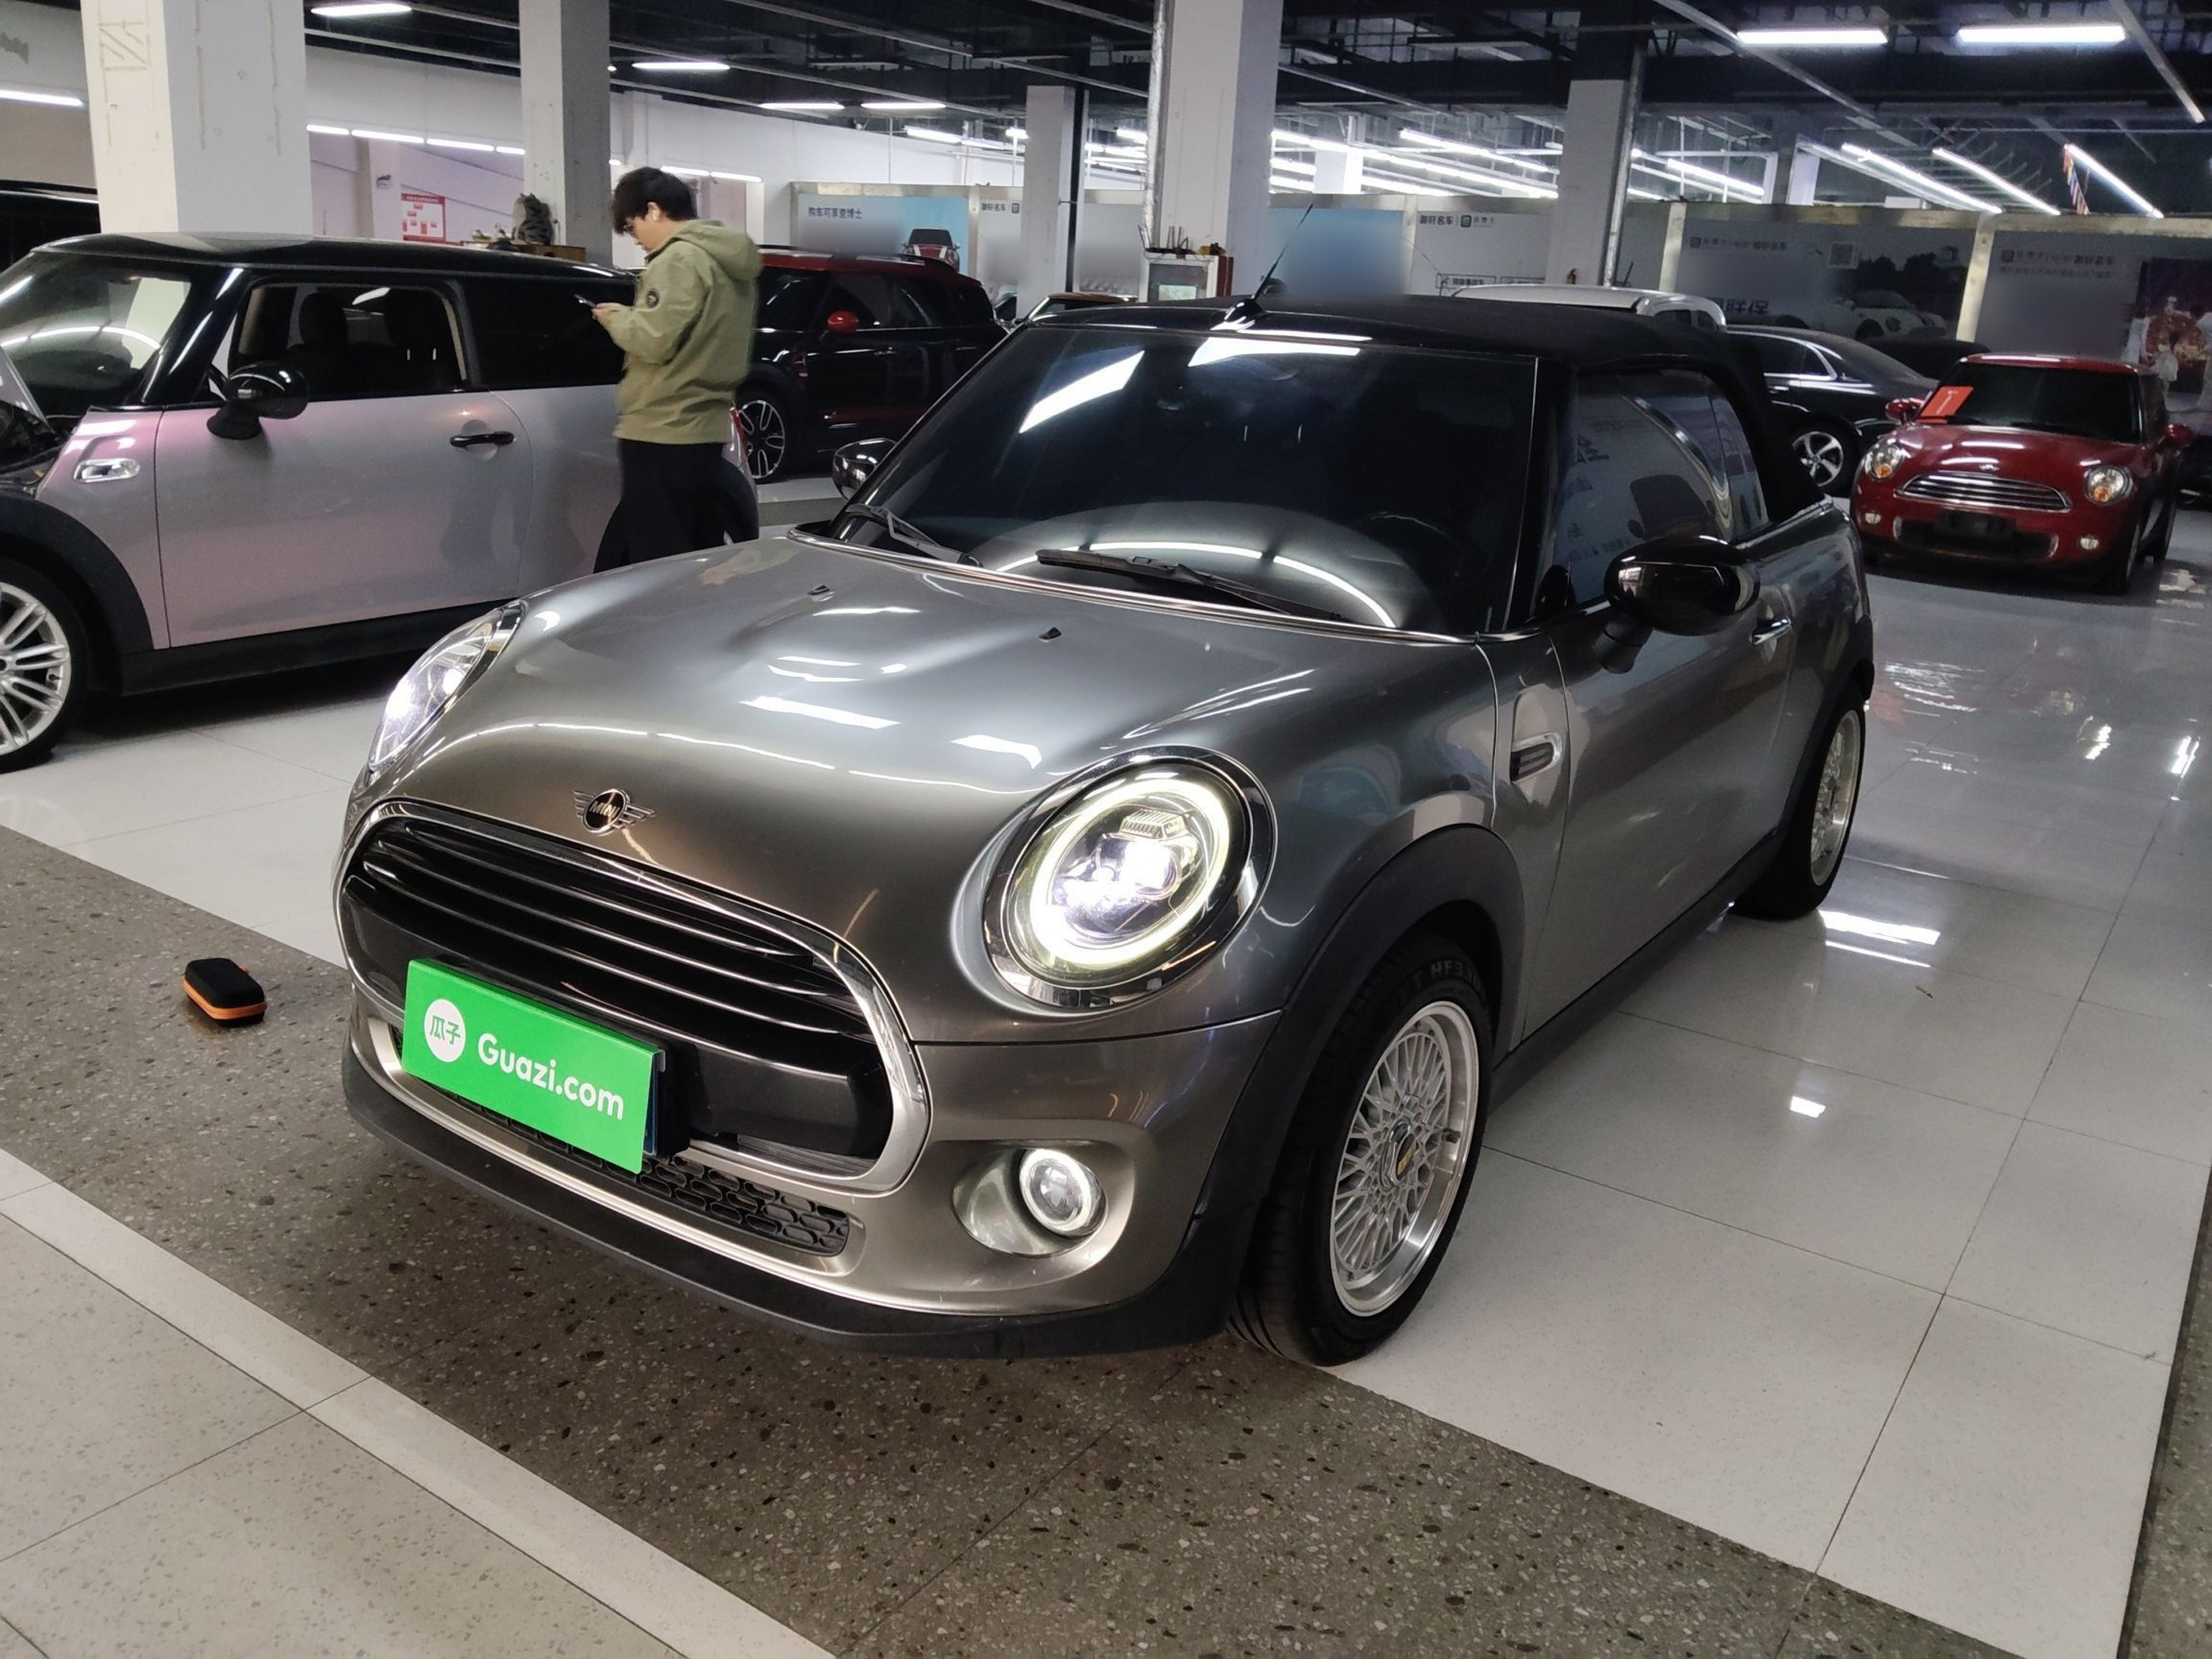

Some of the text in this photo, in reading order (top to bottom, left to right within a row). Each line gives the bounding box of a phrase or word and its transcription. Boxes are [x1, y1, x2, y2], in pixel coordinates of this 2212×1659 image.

[589, 800, 620, 820] MINI
[429, 1014, 461, 1046] 瓜子
[478, 1032, 624, 1120] Guazi.com
